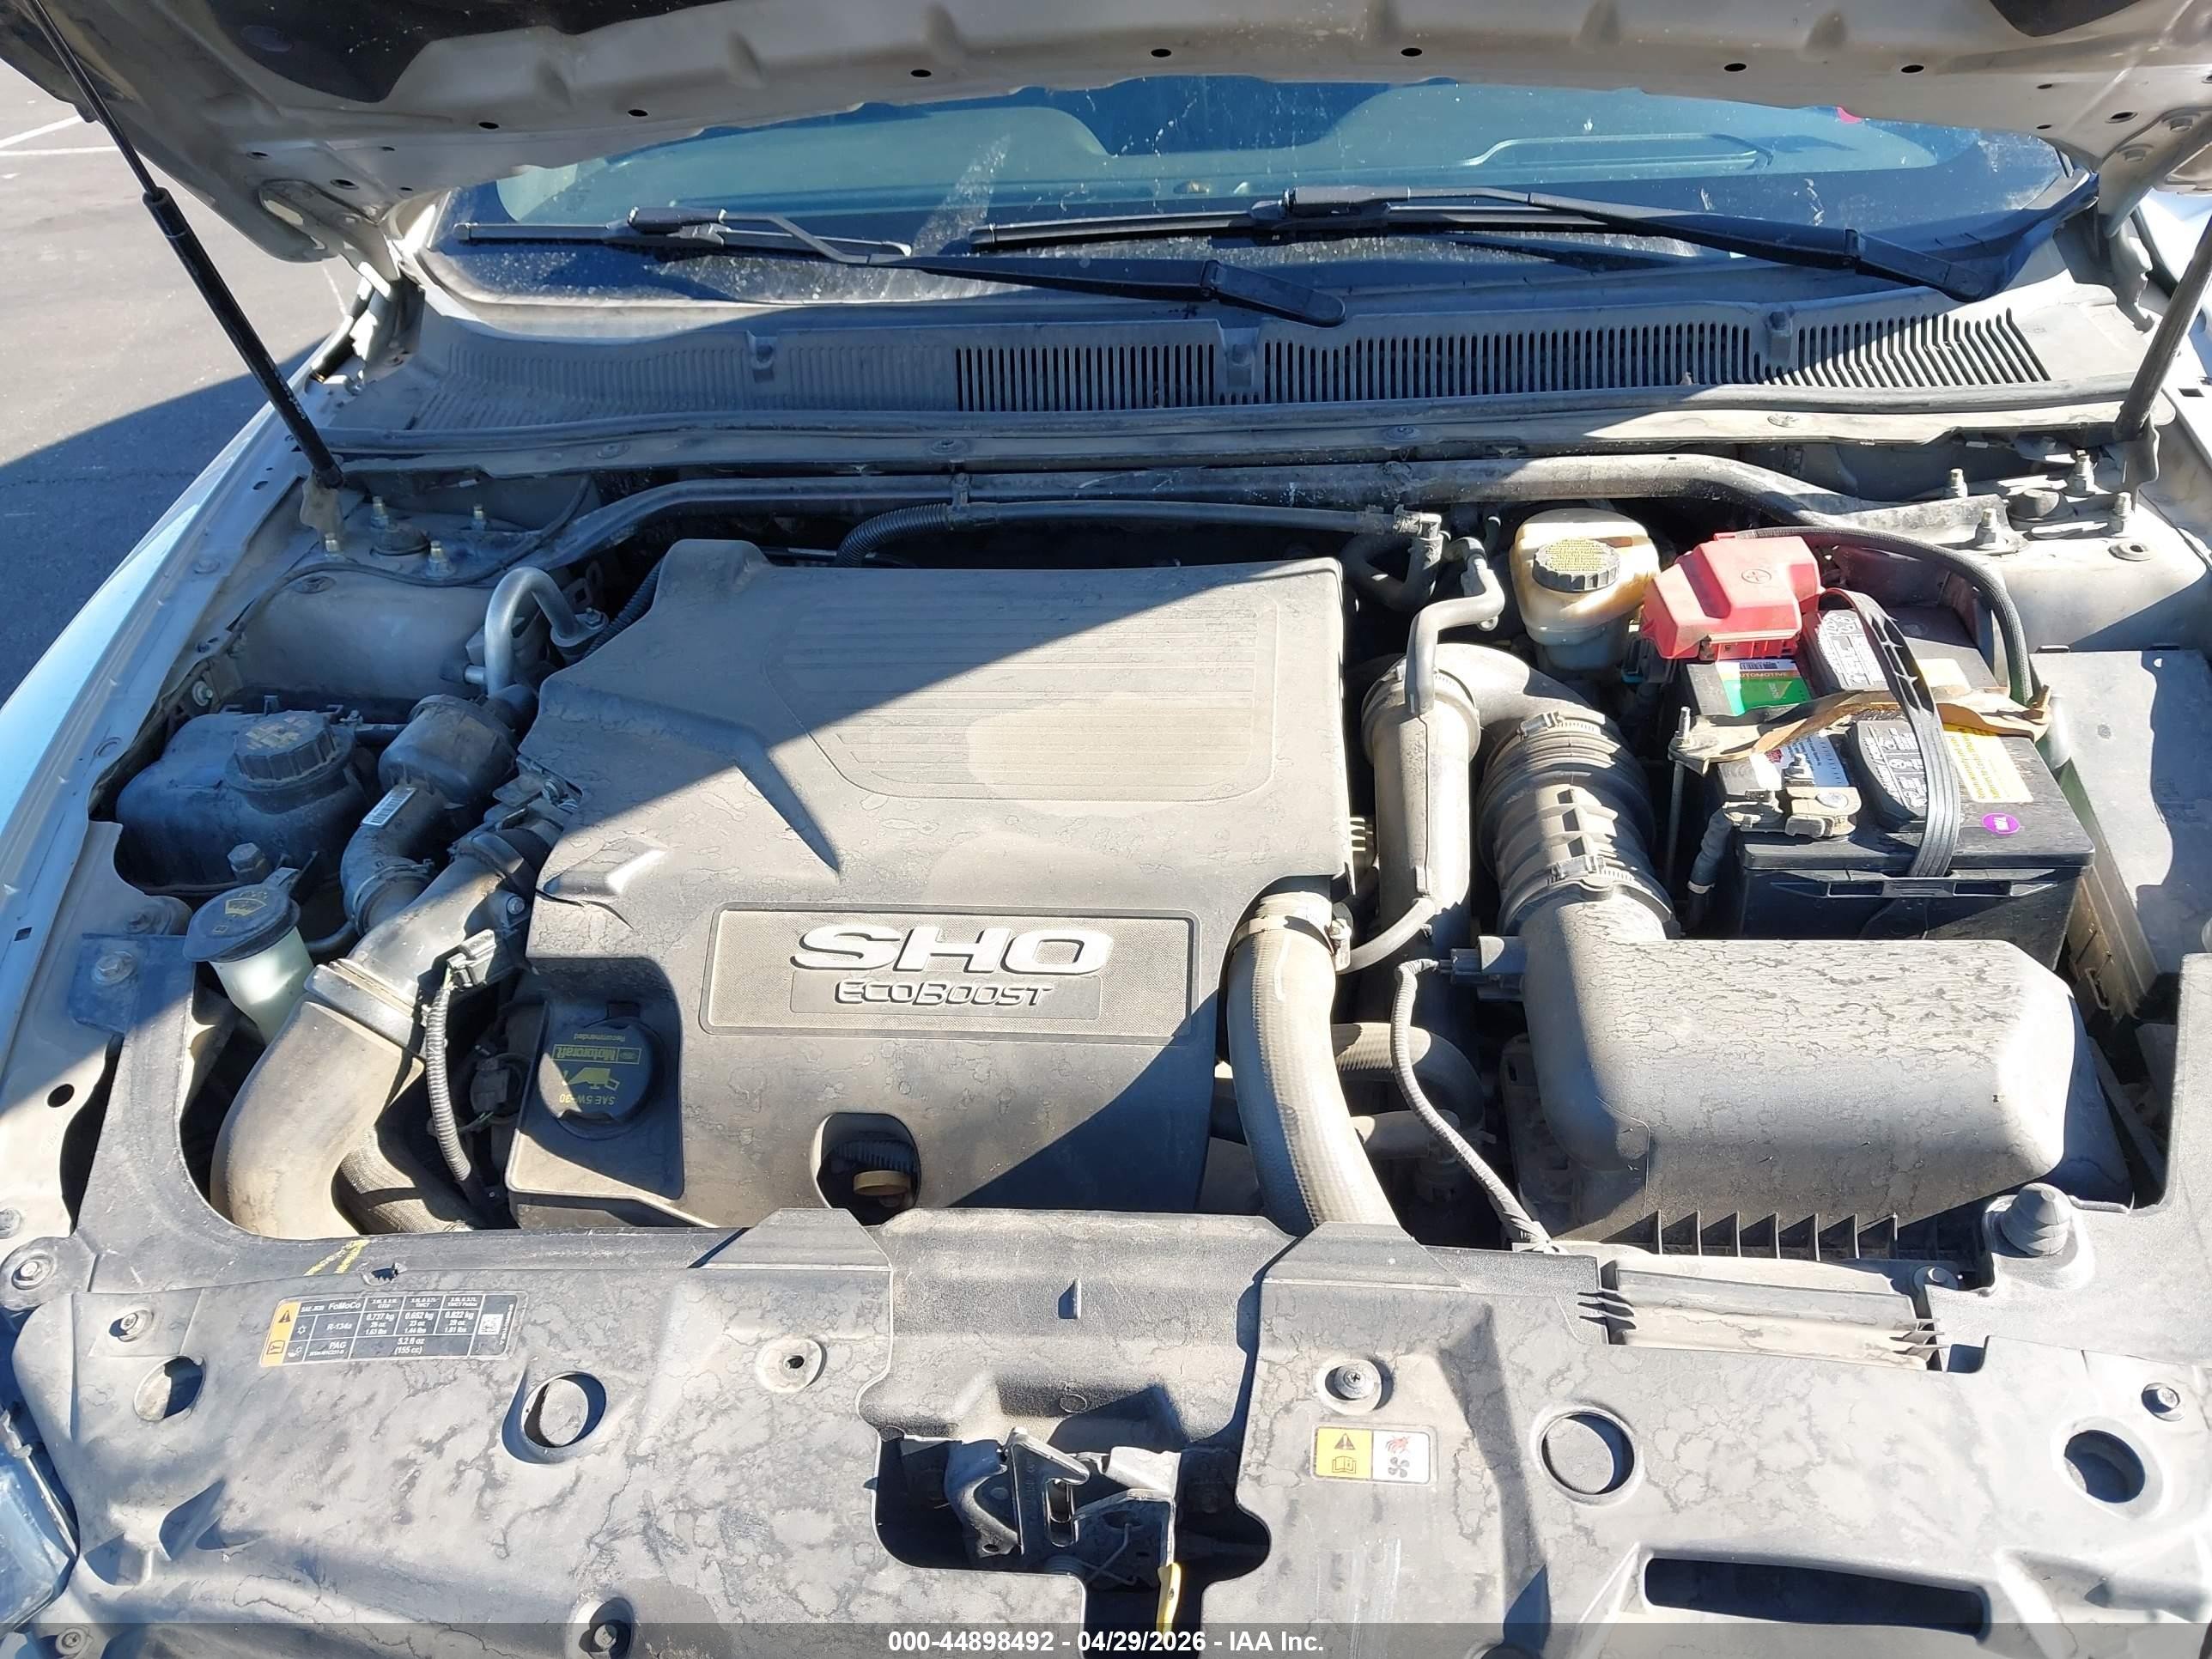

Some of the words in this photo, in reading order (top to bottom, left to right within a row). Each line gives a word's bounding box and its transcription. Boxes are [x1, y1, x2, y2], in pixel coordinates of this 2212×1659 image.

[790, 924, 1115, 975] SHO
[556, 1046, 617, 1061] Motorcraft
[559, 1093, 594, 1104] 5W-30
[595, 1095, 617, 1105] SAE
[328, 1301, 362, 1310] FoMoCo
[385, 1313, 395, 1322] kg
[404, 1311, 424, 1320] 0.652
[424, 1311, 434, 1321] kg
[465, 1310, 474, 1320] kg
[326, 1322, 353, 1331] R-134a
[329, 1341, 347, 1350] PAG
[394, 1346, 410, 1355] (155
